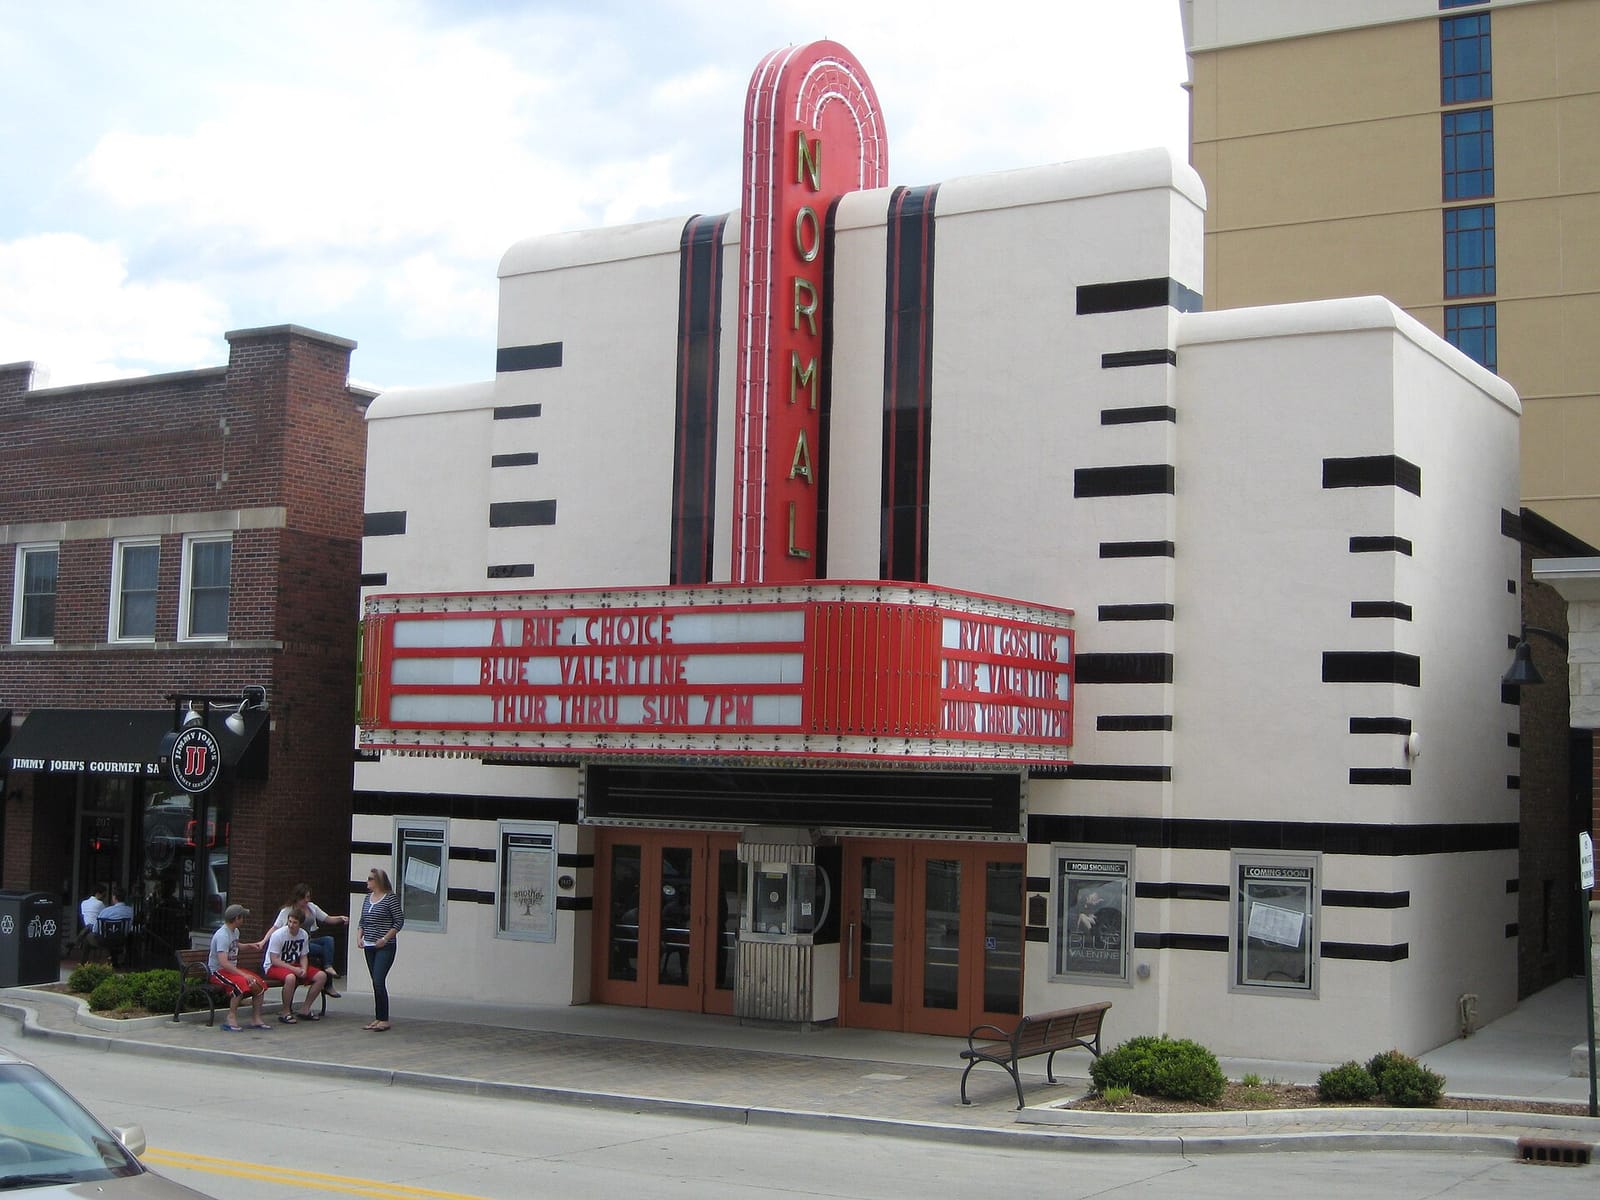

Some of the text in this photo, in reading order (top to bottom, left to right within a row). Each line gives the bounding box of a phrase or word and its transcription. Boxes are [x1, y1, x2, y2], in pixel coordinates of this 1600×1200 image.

[788, 130, 821, 559] NORMAL
[492, 615, 675, 646] A BNF CHOICE
[960, 620, 1058, 662] RYAN GOSLING
[480, 655, 688, 686] BLUE VALENTINE
[946, 659, 1060, 701] BLUE VALENTINE
[491, 694, 754, 724] THUR THRU SUN 7PM
[940, 700, 1068, 738] THUR THRU SUN 7PM
[175, 732, 217, 761] JIMMY JOHN'S
[185, 746, 207, 775] JJ
[12, 758, 45, 769] JIMMY
[50, 760, 85, 771] JOHN'S
[90, 761, 141, 773] GOURMET
[1072, 863, 1120, 872] NOW SHOWING
[1249, 868, 1306, 878] COMING SOON
[282, 939, 305, 952] JUST
[1068, 949, 1120, 961] VALENTINE
